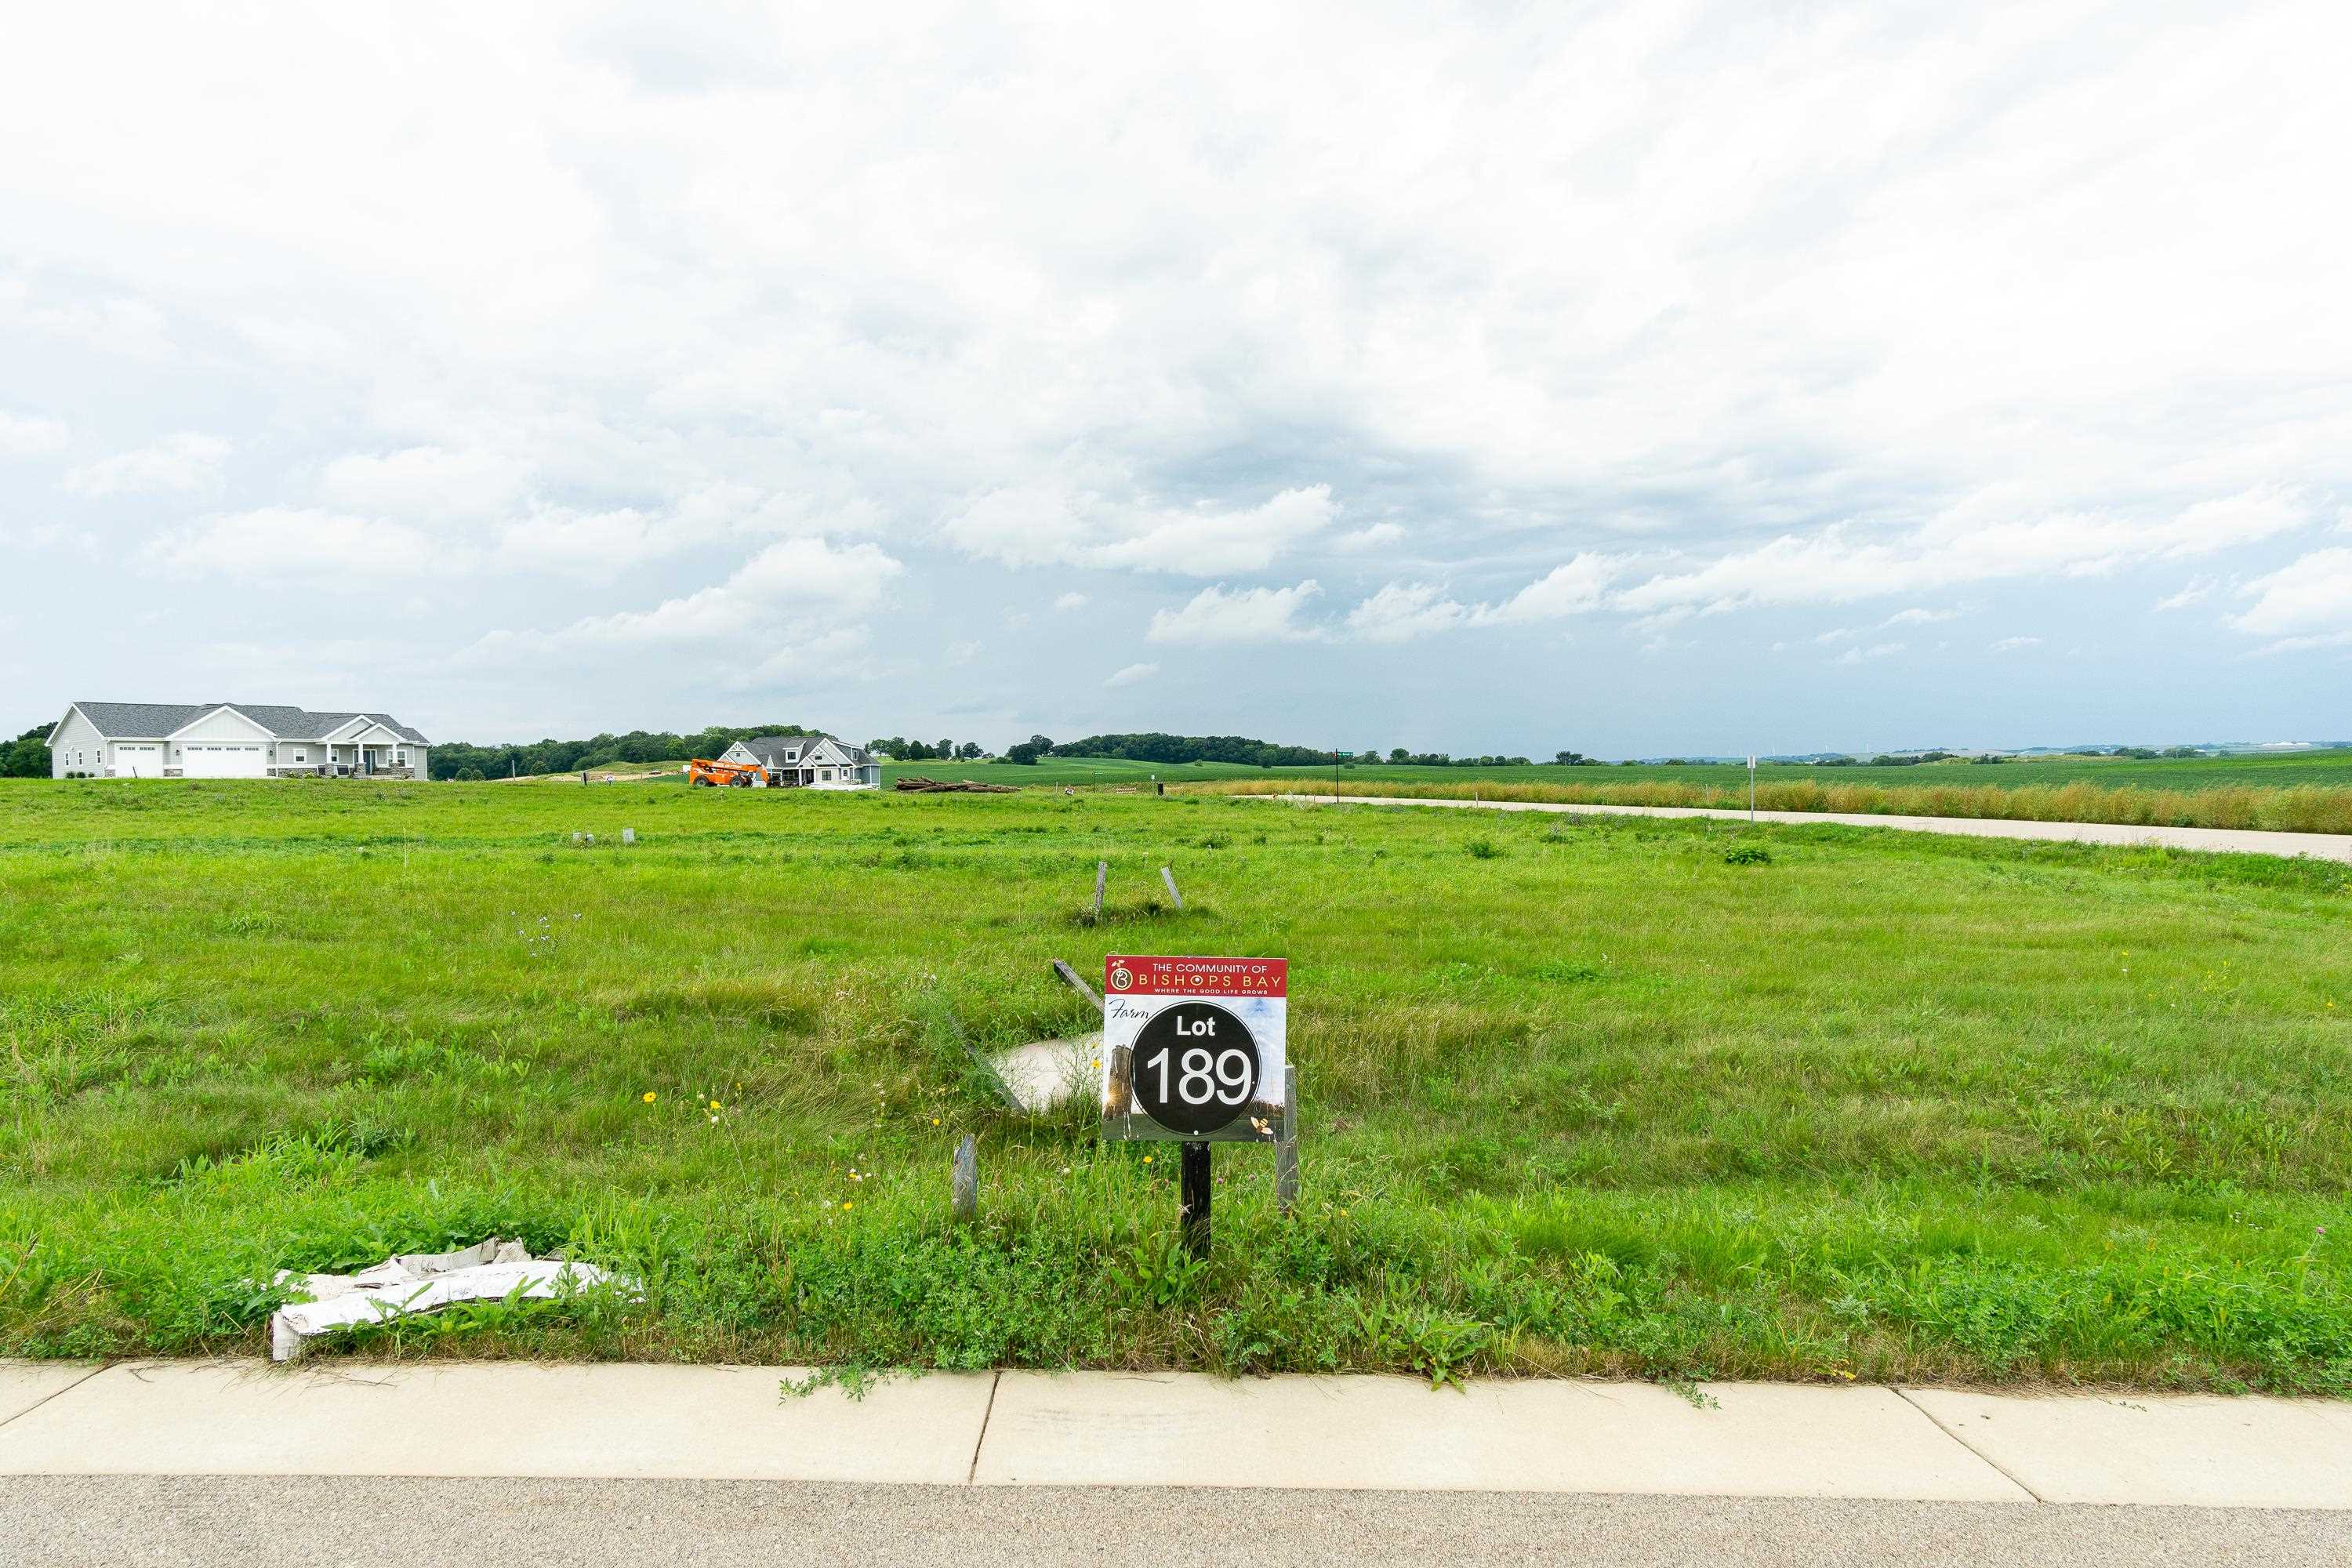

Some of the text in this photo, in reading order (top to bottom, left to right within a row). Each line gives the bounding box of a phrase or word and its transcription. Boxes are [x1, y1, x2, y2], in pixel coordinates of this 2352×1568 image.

[1152, 963, 1268, 974] THE COMMUNITY OF
[1138, 974, 1281, 987] BISHOPS BAY
[1109, 998, 1149, 1018] Farm
[1177, 1015, 1216, 1036] Lot
[1147, 1047, 1252, 1105] 189
